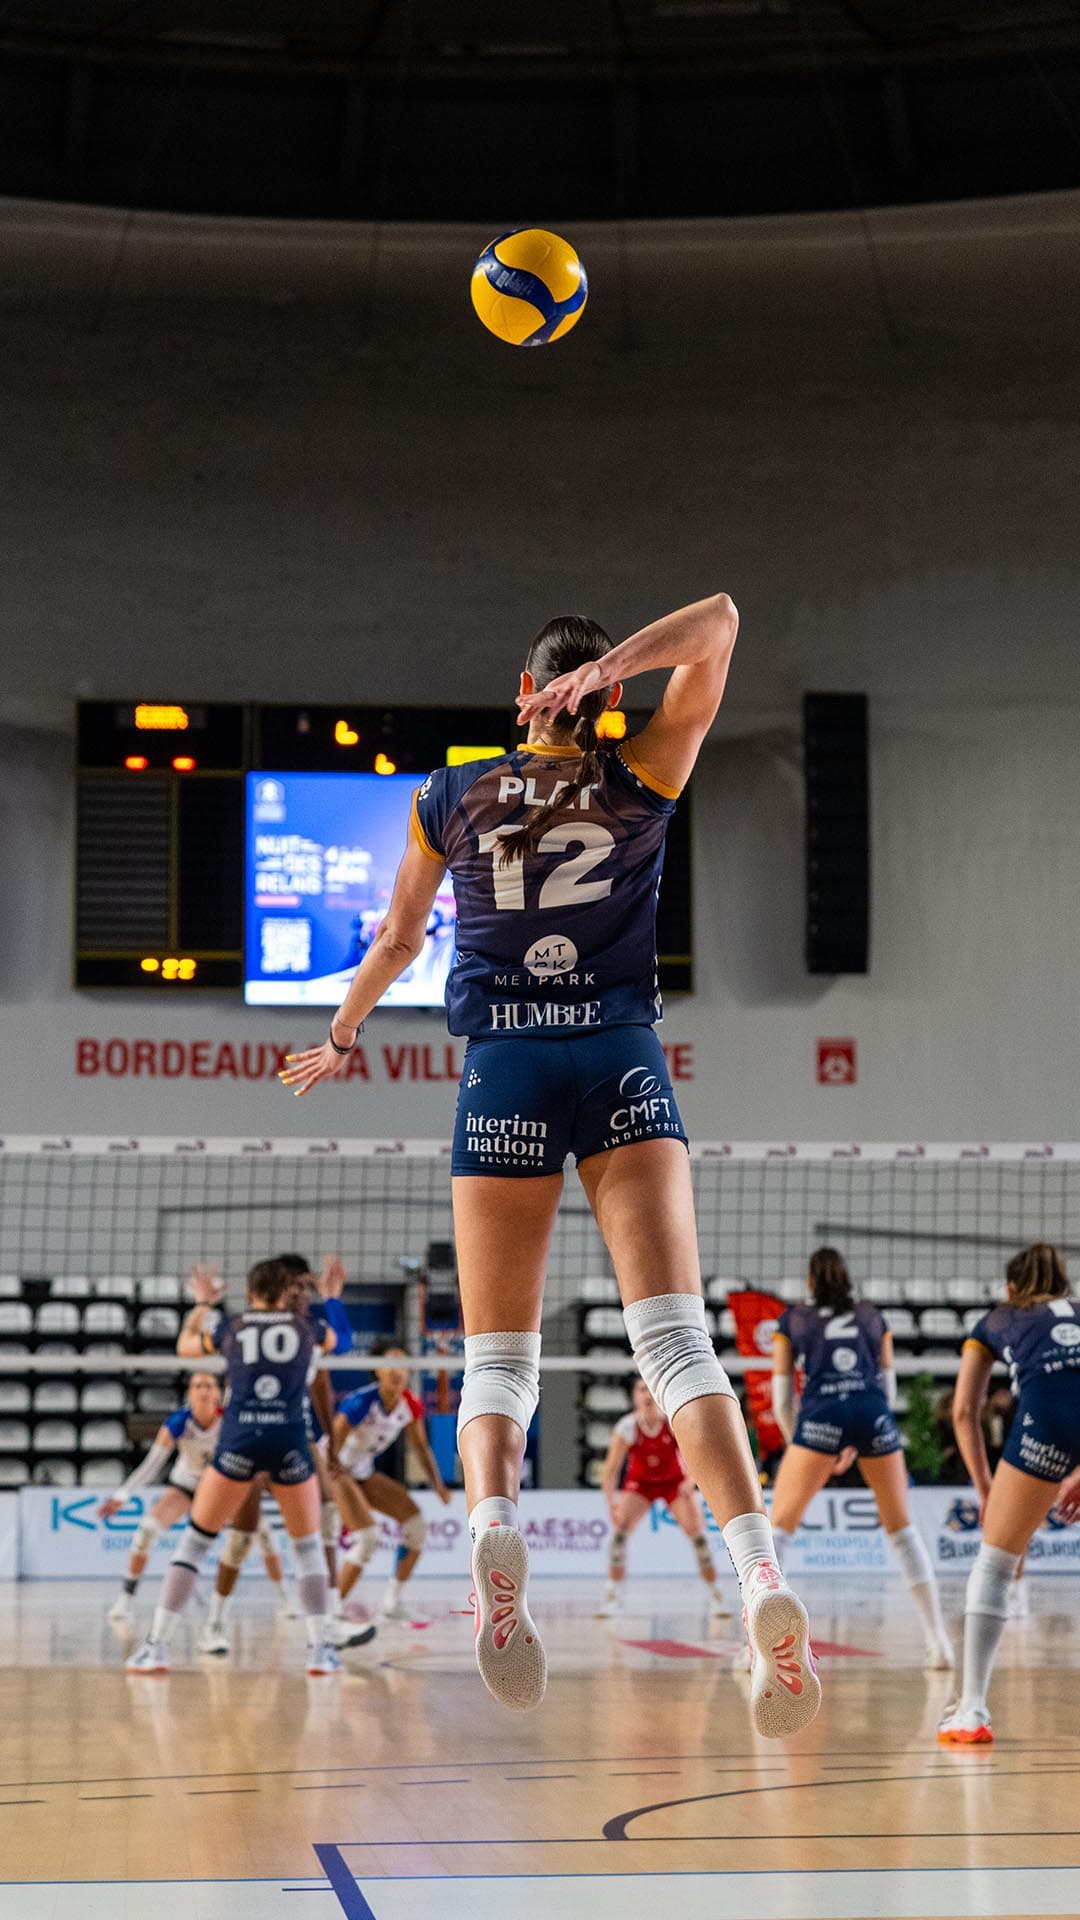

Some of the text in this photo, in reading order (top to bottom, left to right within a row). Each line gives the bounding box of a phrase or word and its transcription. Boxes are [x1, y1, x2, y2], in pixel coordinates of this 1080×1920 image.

[478, 822, 616, 910] 12
[489, 1001, 601, 1030] HUMBEE
[75, 1038, 292, 1081] BORDEAUX
[466, 1112, 547, 1138] interim
[610, 1098, 670, 1130] CMFT
[467, 1134, 545, 1158] nation
[604, 1123, 680, 1148] INDUSTRIE
[480, 1156, 543, 1166] BELVEDIA
[236, 1324, 300, 1364] 10
